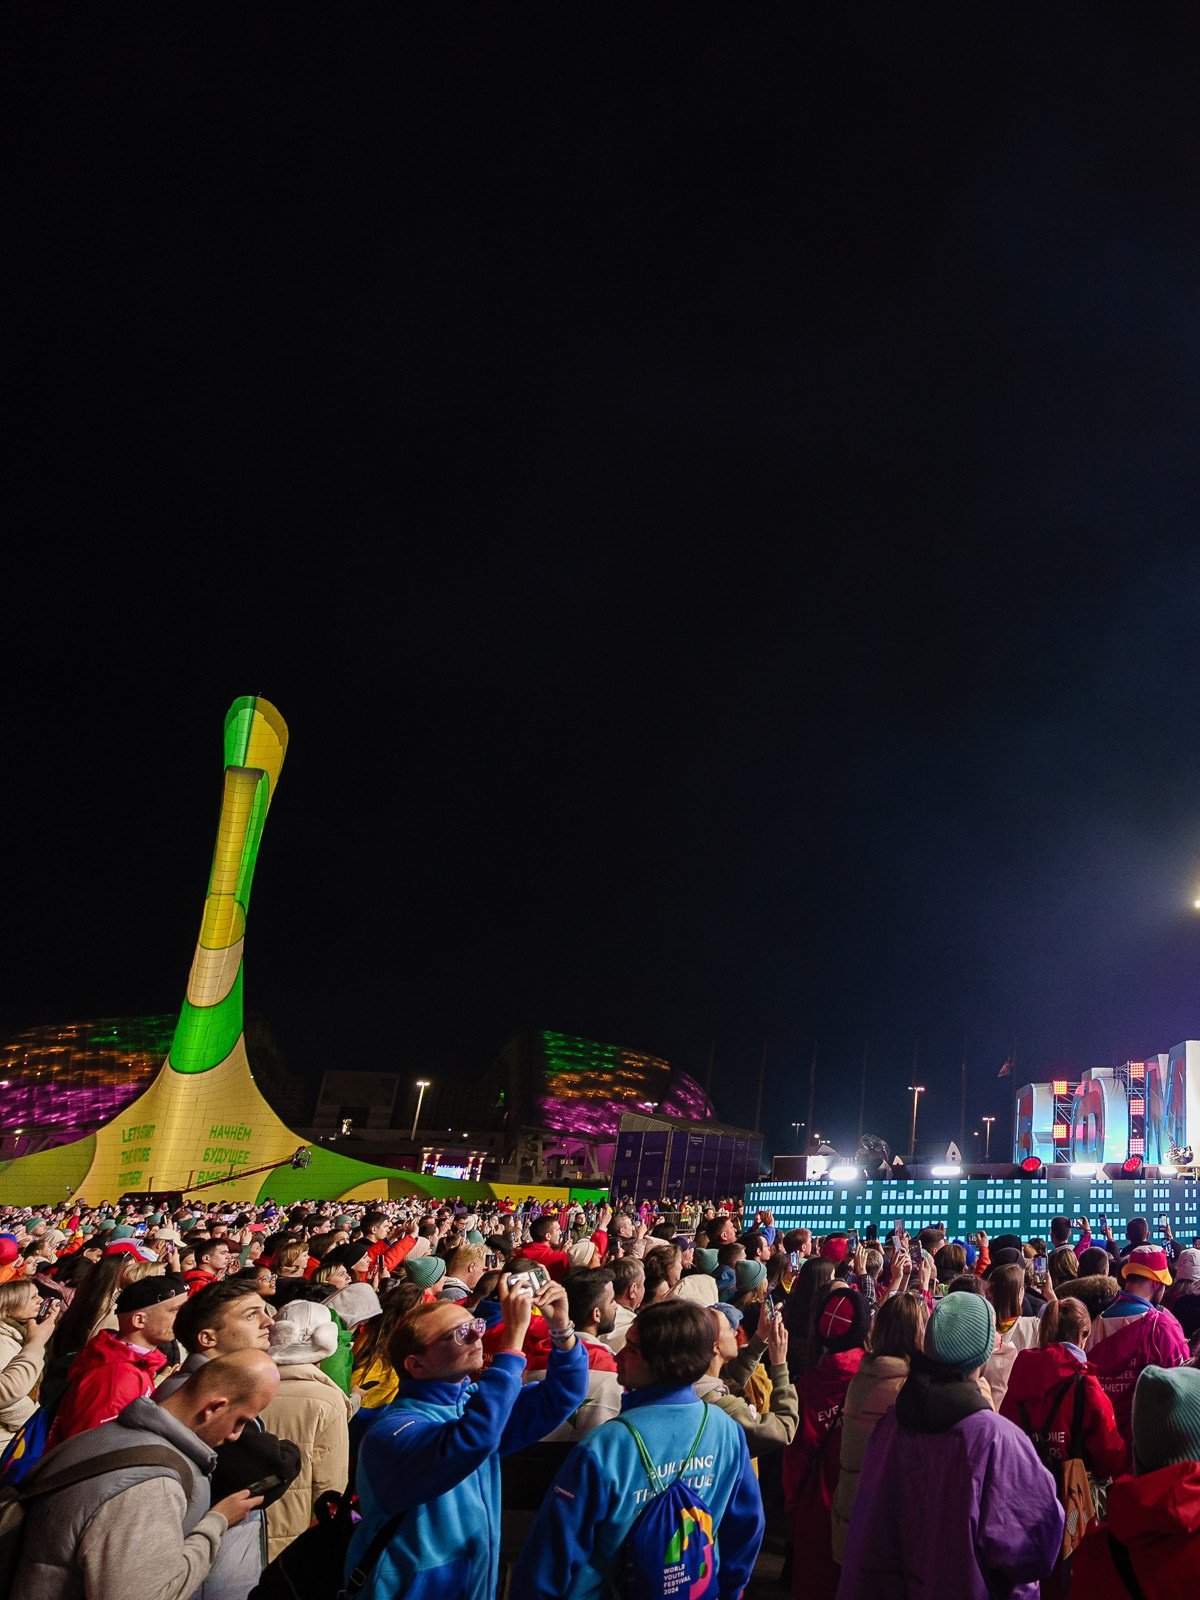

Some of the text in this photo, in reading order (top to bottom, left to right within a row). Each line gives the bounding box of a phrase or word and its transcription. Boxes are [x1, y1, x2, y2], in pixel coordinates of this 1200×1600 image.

[209, 1122, 252, 1142] НАЧНЁМ
[202, 1147, 251, 1165] БУДУЩЕЕ
[663, 1563, 686, 1574] WORLD
[663, 1570, 685, 1581] YOUTH
[663, 1575, 691, 1588] FESTIVAL
[663, 1586, 679, 1596] 2024
